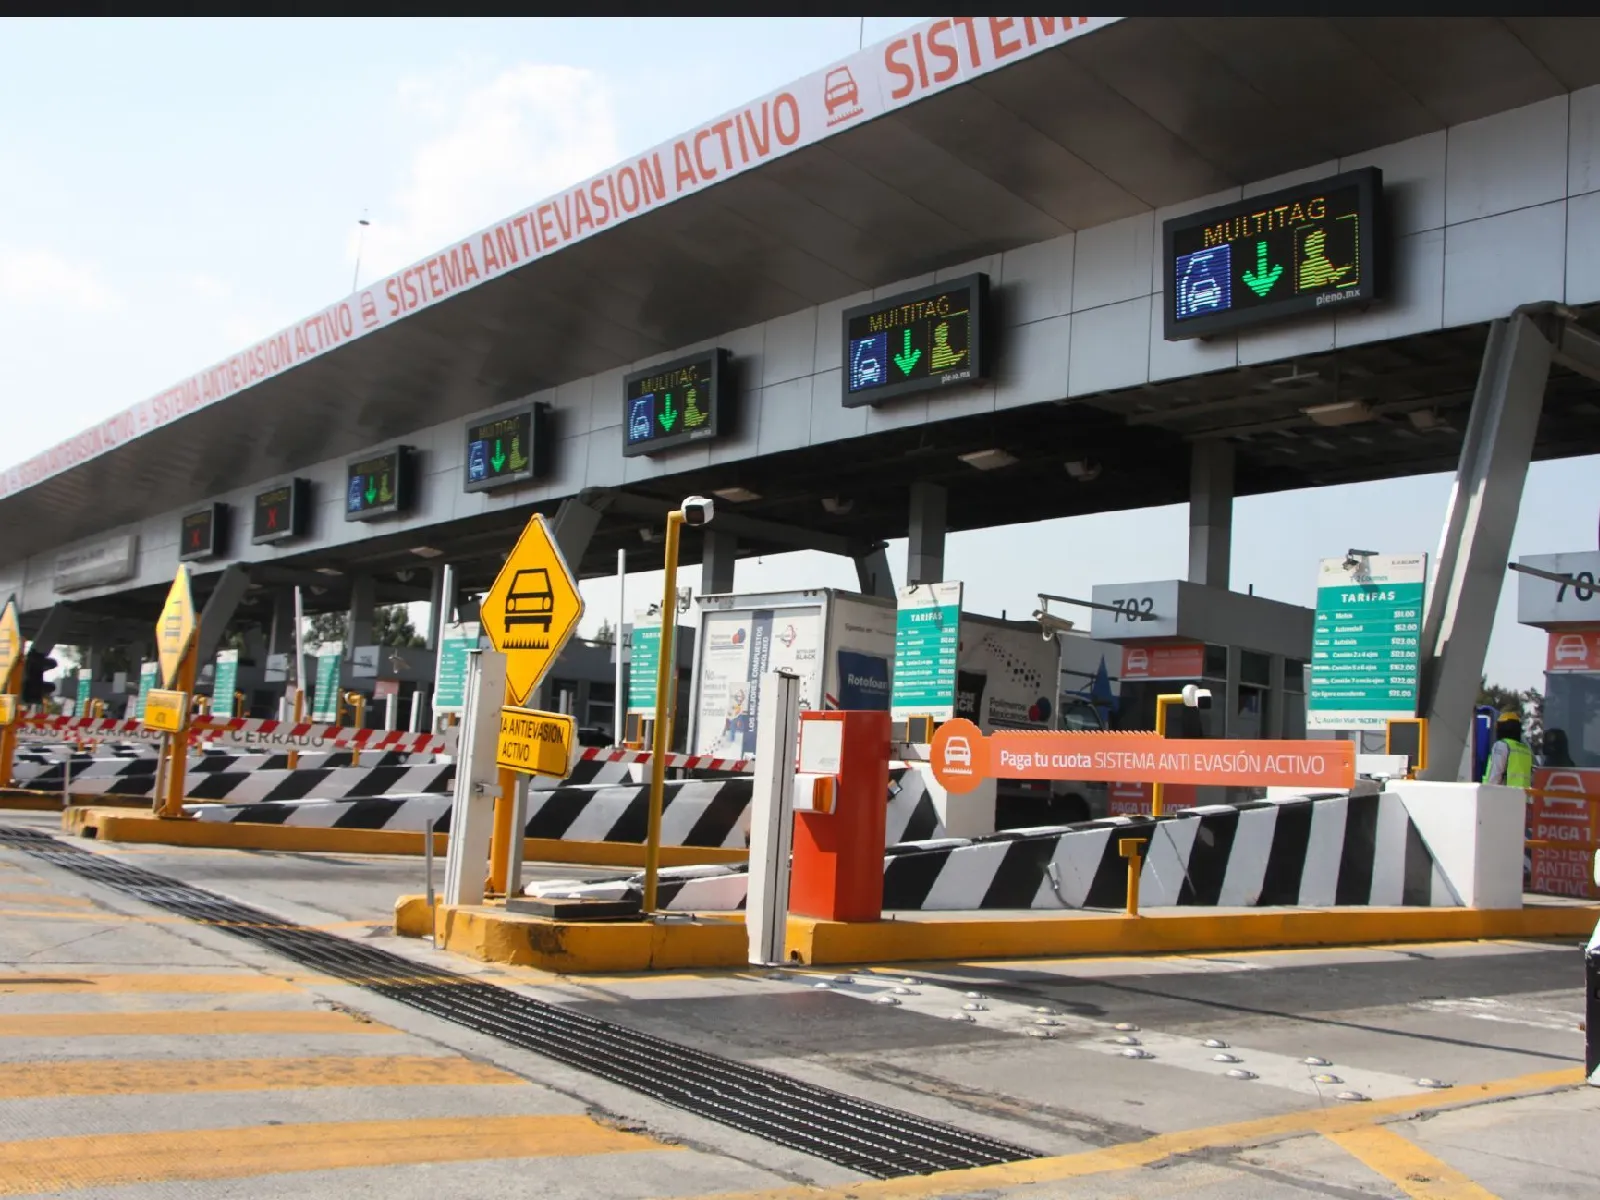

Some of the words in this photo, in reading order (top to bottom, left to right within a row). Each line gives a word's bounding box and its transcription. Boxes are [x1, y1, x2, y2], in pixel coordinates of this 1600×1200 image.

[884, 17, 1088, 100] SISTEM
[385, 242, 480, 317] SISTEMA
[481, 152, 666, 276] ANTIEVASION
[674, 92, 801, 193] ACTIVO
[1204, 197, 1325, 247] MULTITAG
[1315, 289, 1361, 306] pleno.mx
[869, 295, 949, 332] MULTITAG
[294, 303, 353, 357] ACTIVO
[1340, 590, 1396, 603] TARIFAS
[910, 612, 943, 622] TARIFAS
[1112, 597, 1154, 623] 702
[231, 731, 326, 748] CERRADO
[509, 718, 565, 744] ANTIEVASION
[502, 740, 530, 762] ACTIVO
[1000, 750, 1032, 770] Paga
[1034, 752, 1049, 767] tu
[1052, 754, 1092, 768] cuota
[1094, 751, 1157, 771] SISTEMA
[1158, 752, 1190, 771] ANTI
[1194, 748, 1261, 774] EVASIÓN
[1264, 754, 1326, 775] ACTIVO
[1537, 824, 1580, 840] PAGA
